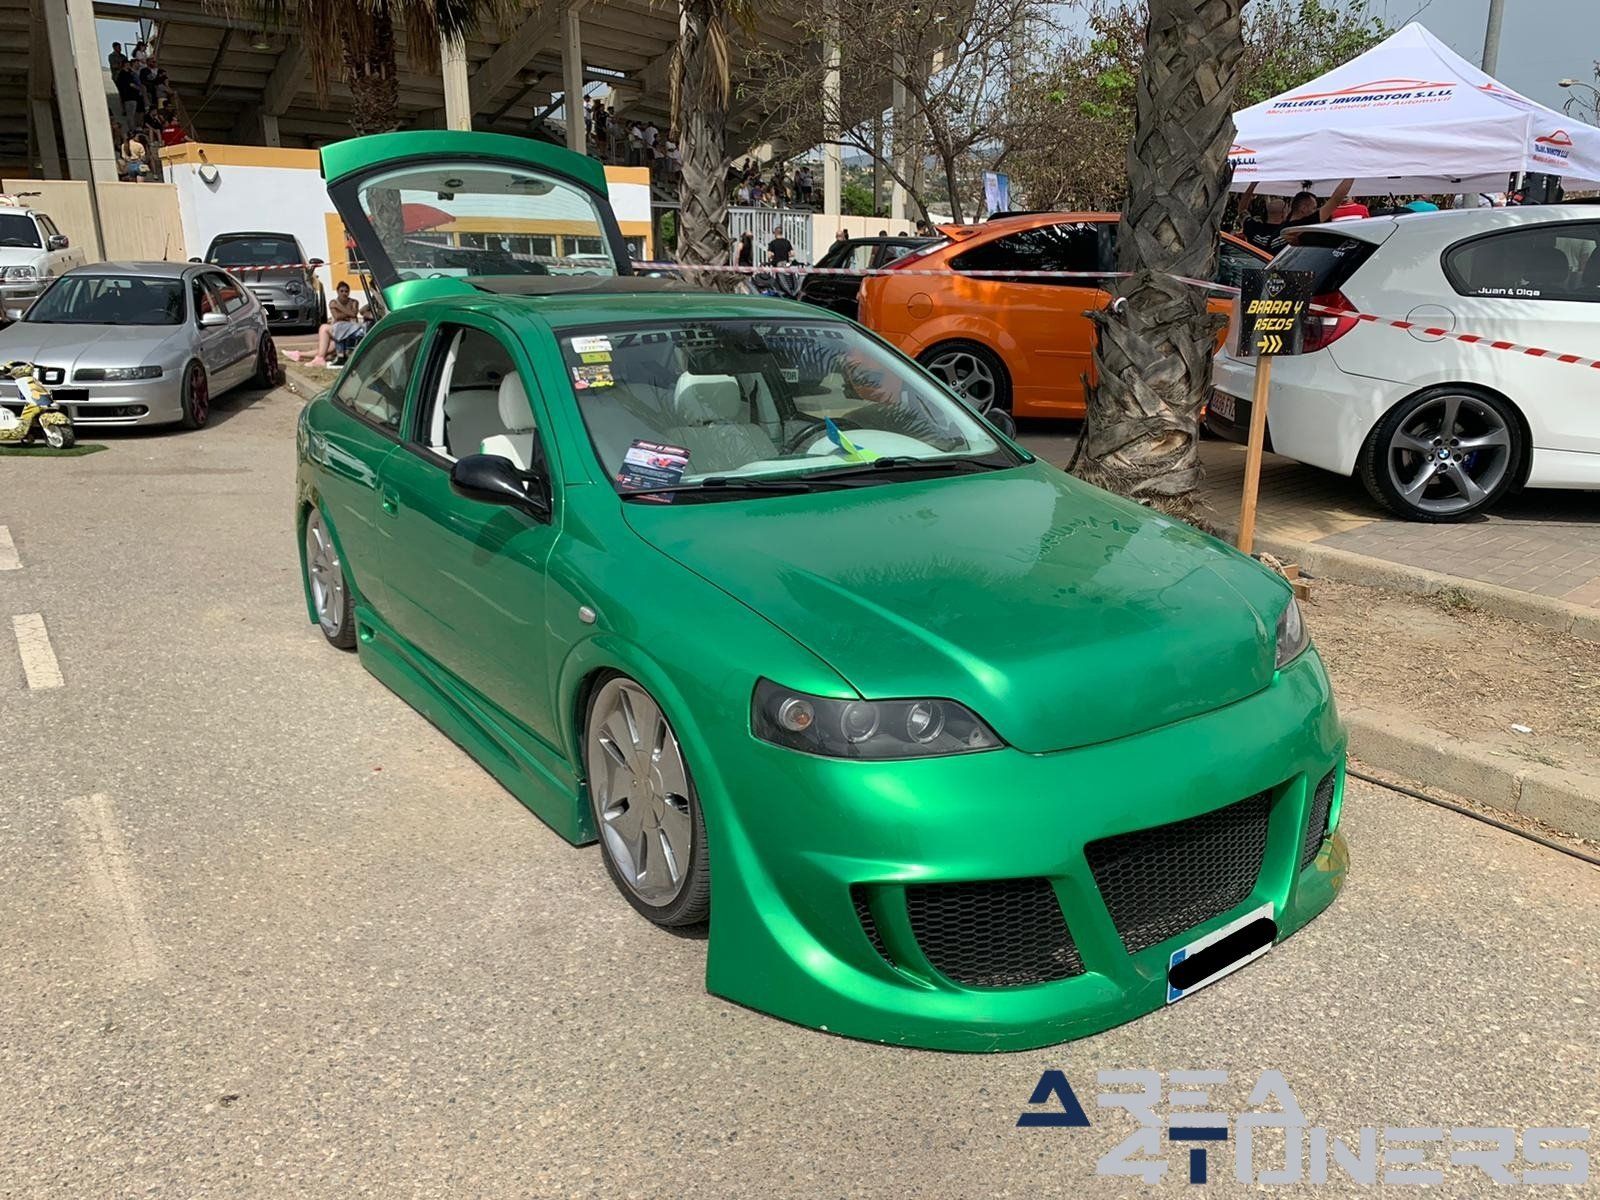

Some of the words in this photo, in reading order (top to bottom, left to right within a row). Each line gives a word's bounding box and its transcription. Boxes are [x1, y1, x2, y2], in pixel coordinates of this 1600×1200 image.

[1273, 99, 1326, 109] TALLERES
[1329, 93, 1411, 105] JAVAMOTOR
[1413, 89, 1453, 99] S.L.U.
[1478, 287, 1506, 295] Juan
[1247, 300, 1293, 314] BARRA
[1294, 300, 1304, 314] Y
[1254, 318, 1295, 331] ASEOS
